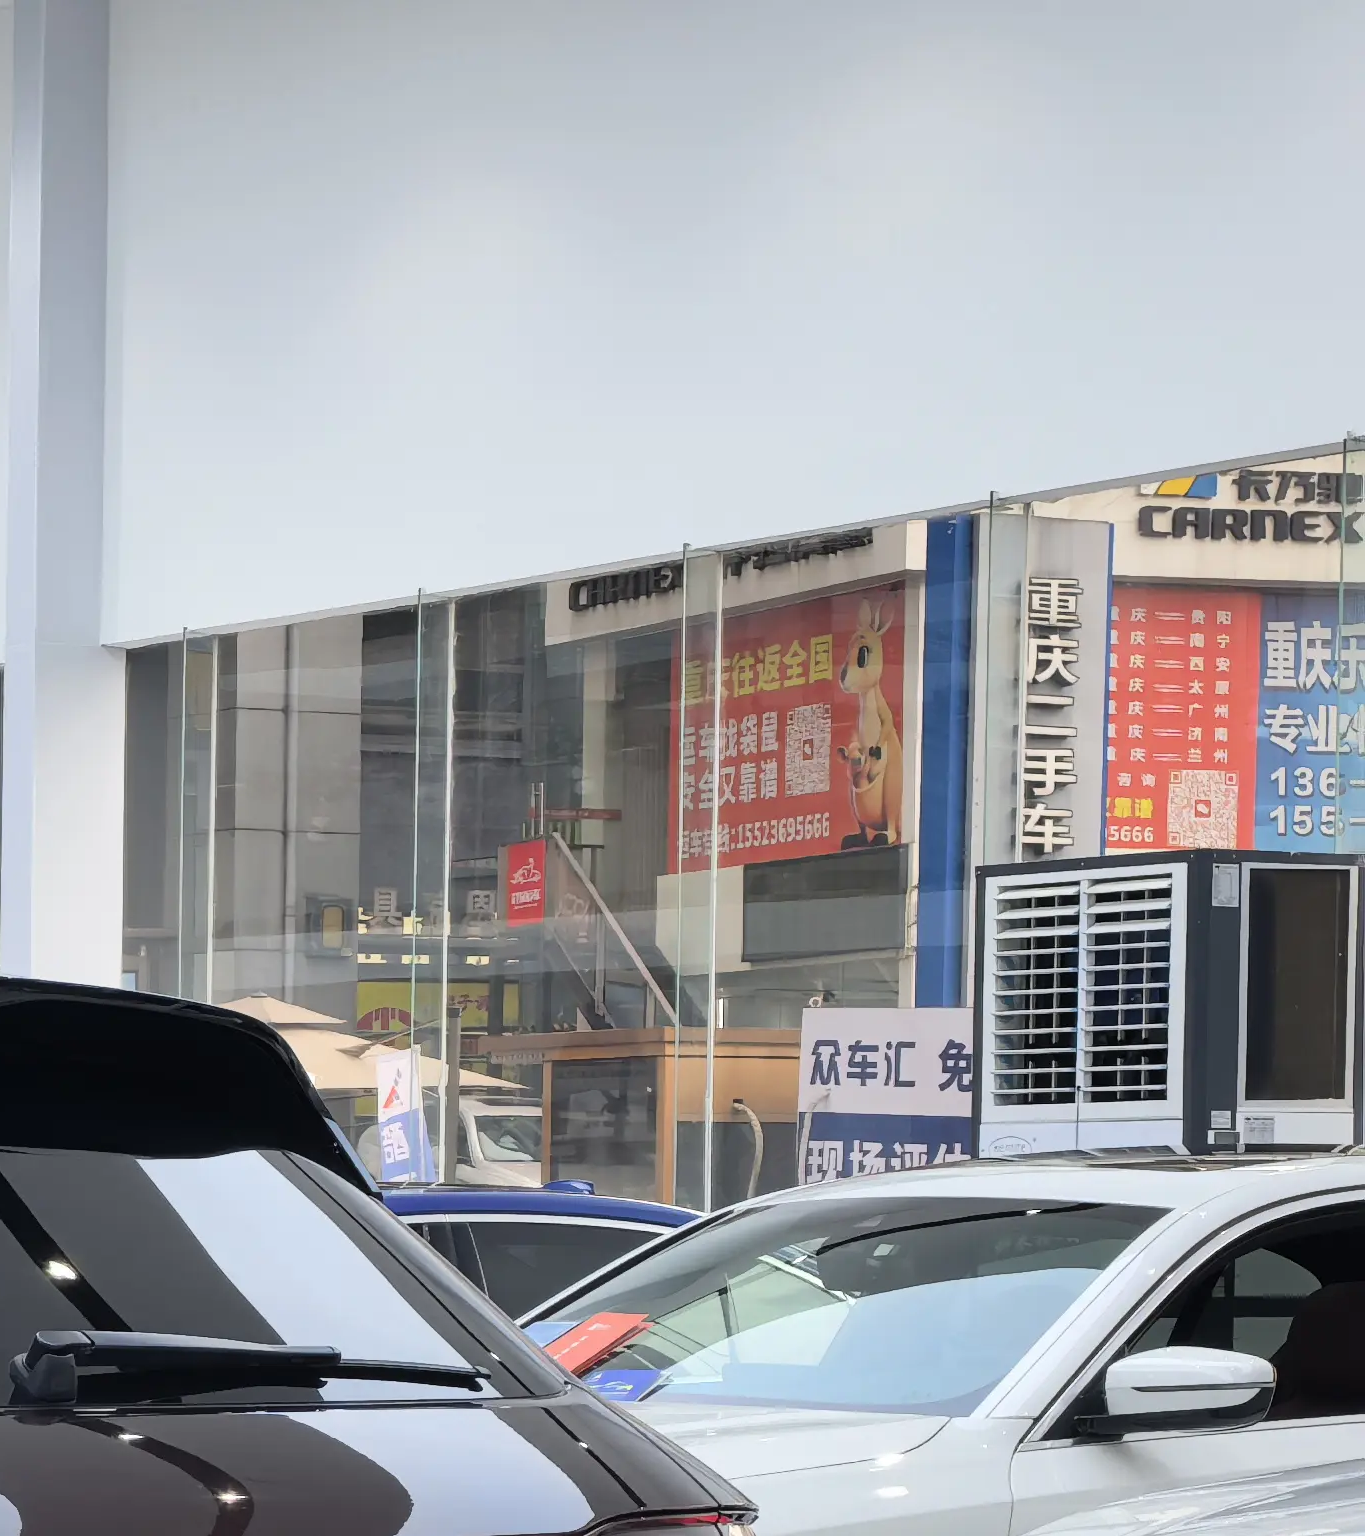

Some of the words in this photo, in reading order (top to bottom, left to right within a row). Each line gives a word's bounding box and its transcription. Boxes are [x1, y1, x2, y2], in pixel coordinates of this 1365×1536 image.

[1138, 505, 1365, 543] CARNEX
[1022, 576, 1084, 854] 重庆二手车
[1105, 825, 1155, 843] 5666
[809, 1039, 916, 1088] 众车汇
